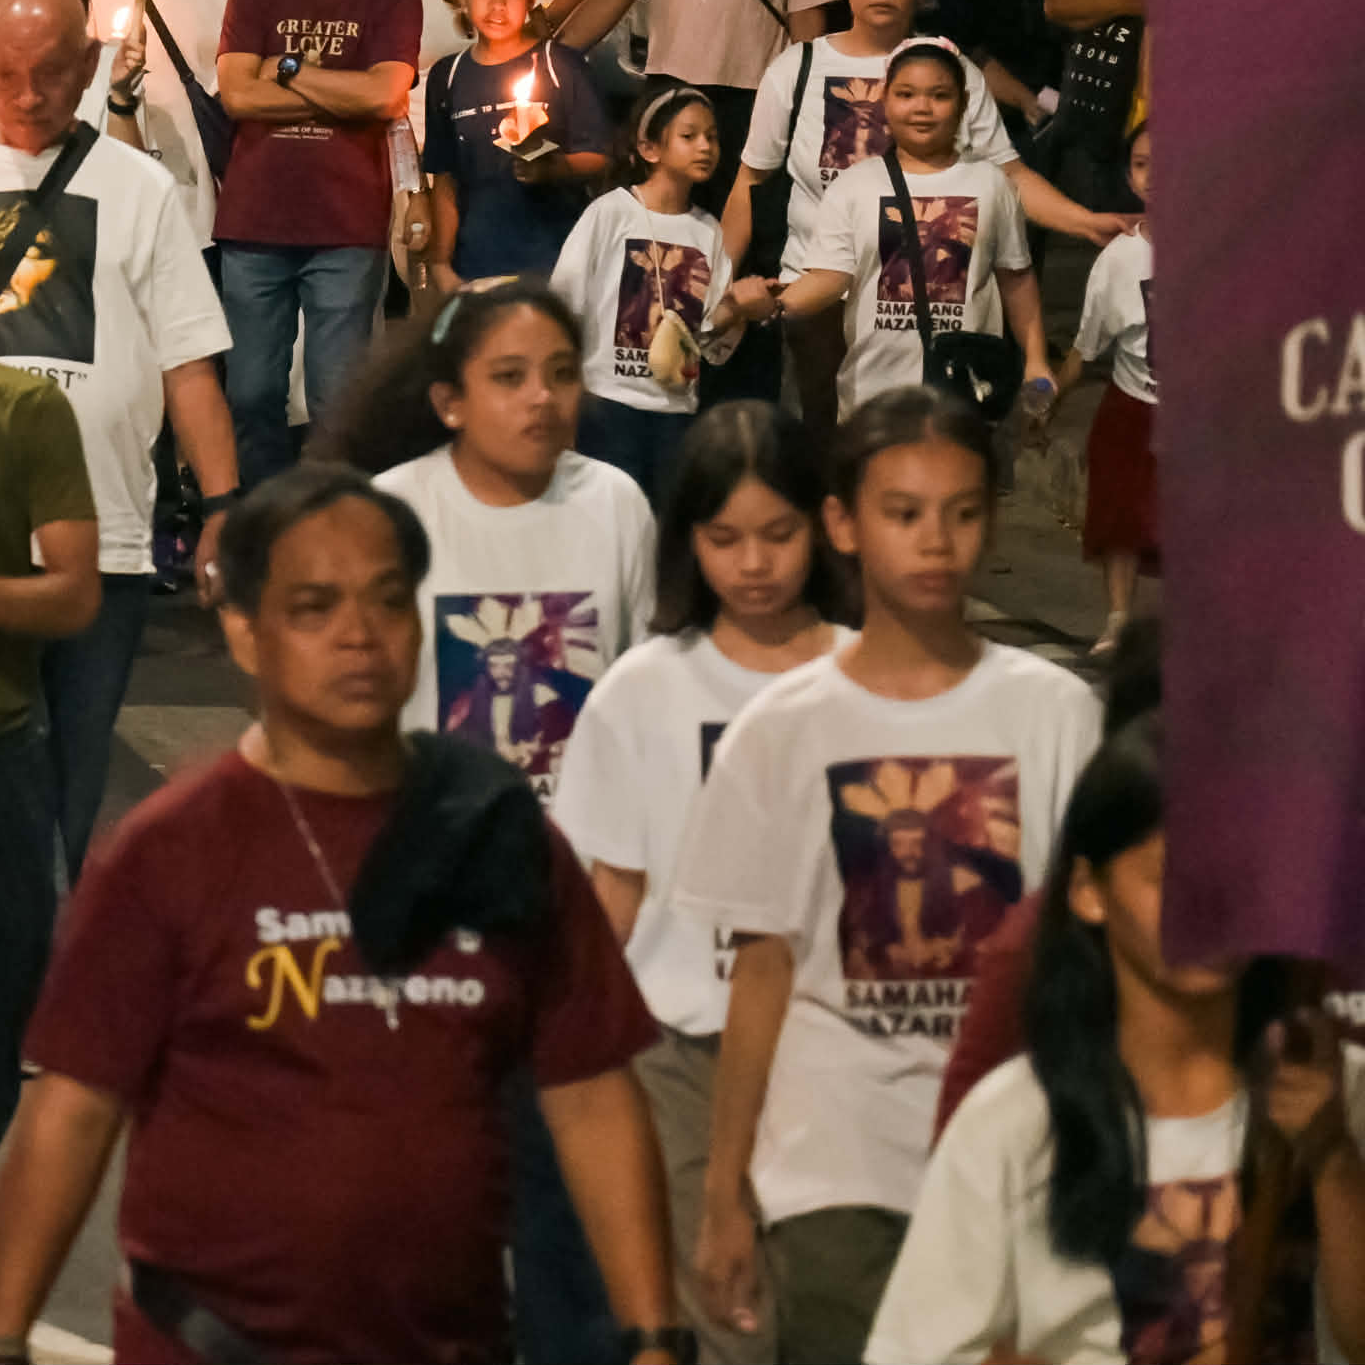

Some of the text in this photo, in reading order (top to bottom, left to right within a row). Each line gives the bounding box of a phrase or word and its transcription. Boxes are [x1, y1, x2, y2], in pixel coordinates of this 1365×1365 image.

[276, 18, 360, 38] GREATER
[284, 34, 345, 56] LOVE
[876, 301, 964, 317] SAMAANG
[874, 317, 963, 332] NAZAENO
